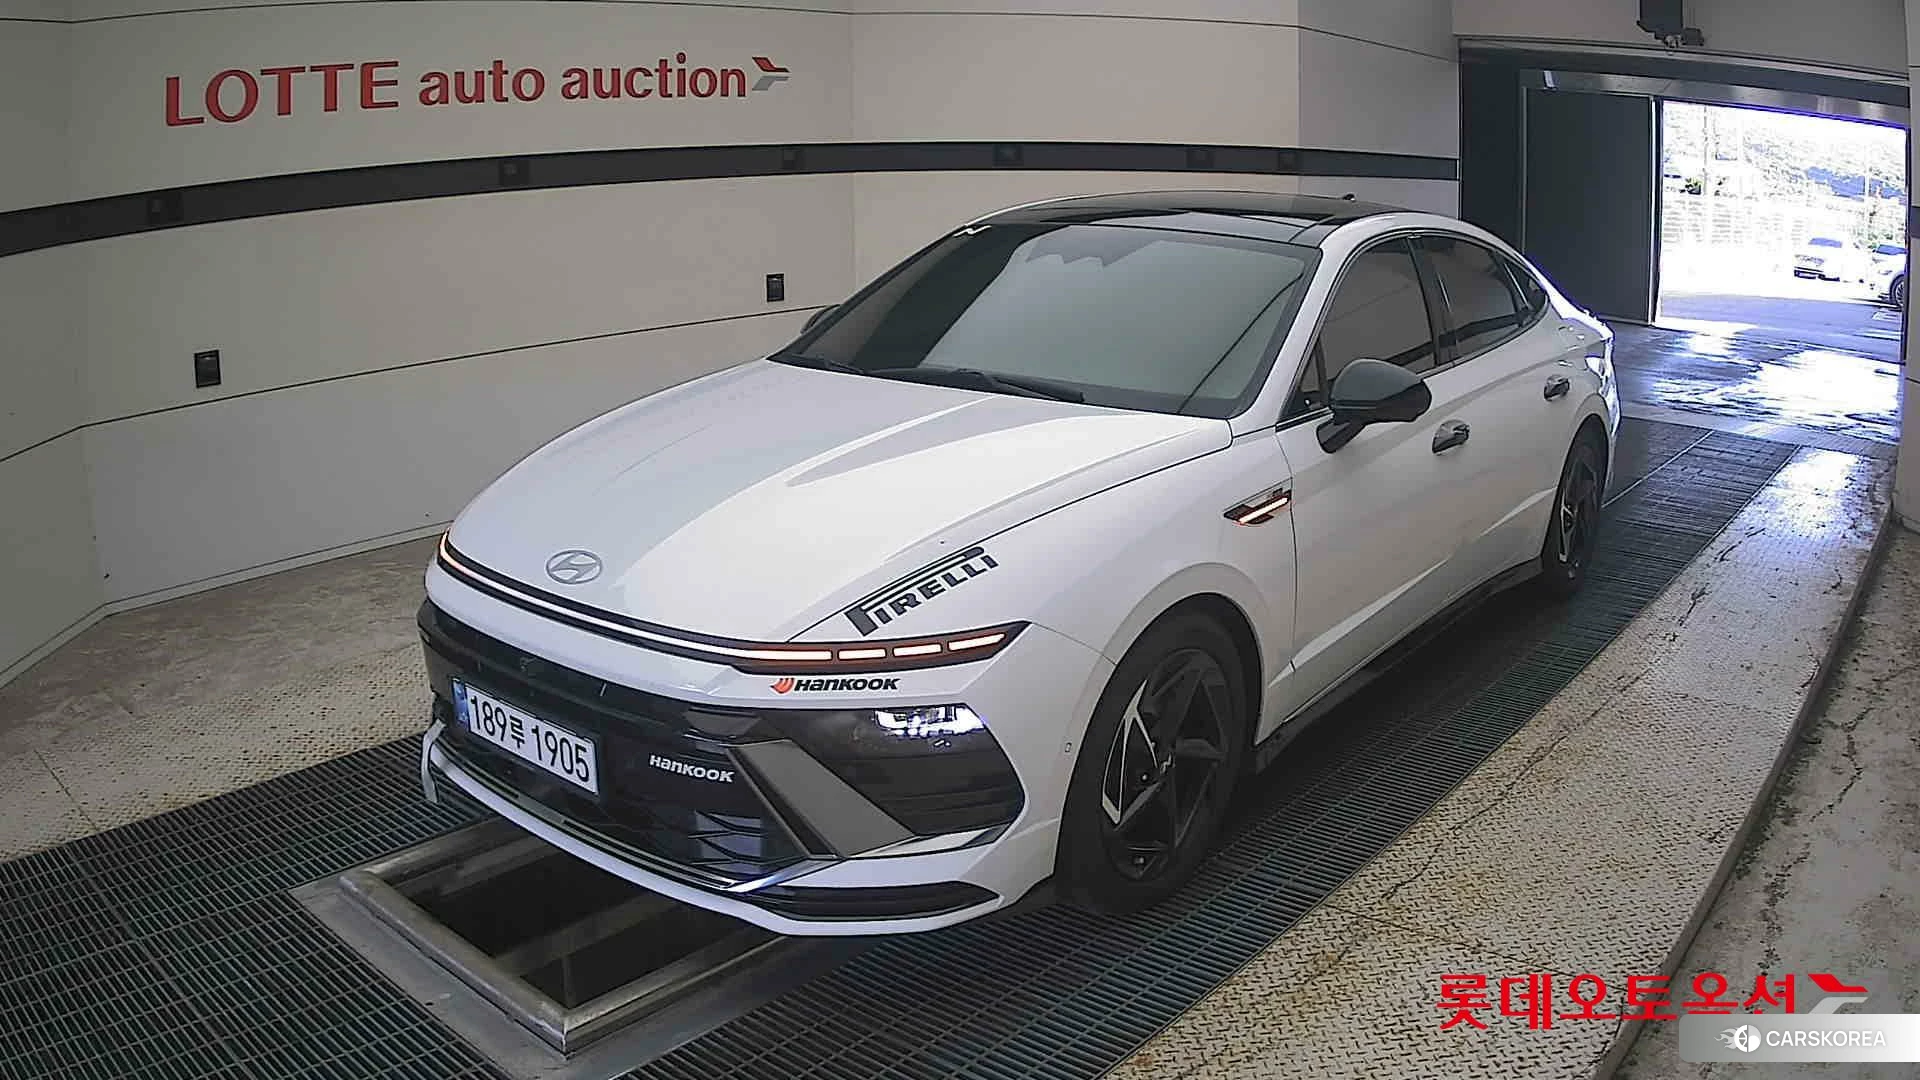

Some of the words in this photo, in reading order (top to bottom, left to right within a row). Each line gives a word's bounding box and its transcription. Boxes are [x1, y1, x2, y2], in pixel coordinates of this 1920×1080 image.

[166, 60, 400, 127] LOTTE
[418, 59, 546, 106] auto
[560, 52, 748, 100] auction
[843, 545, 999, 638] PIRELLI
[470, 695, 525, 749] 189루
[531, 724, 590, 783] 1905
